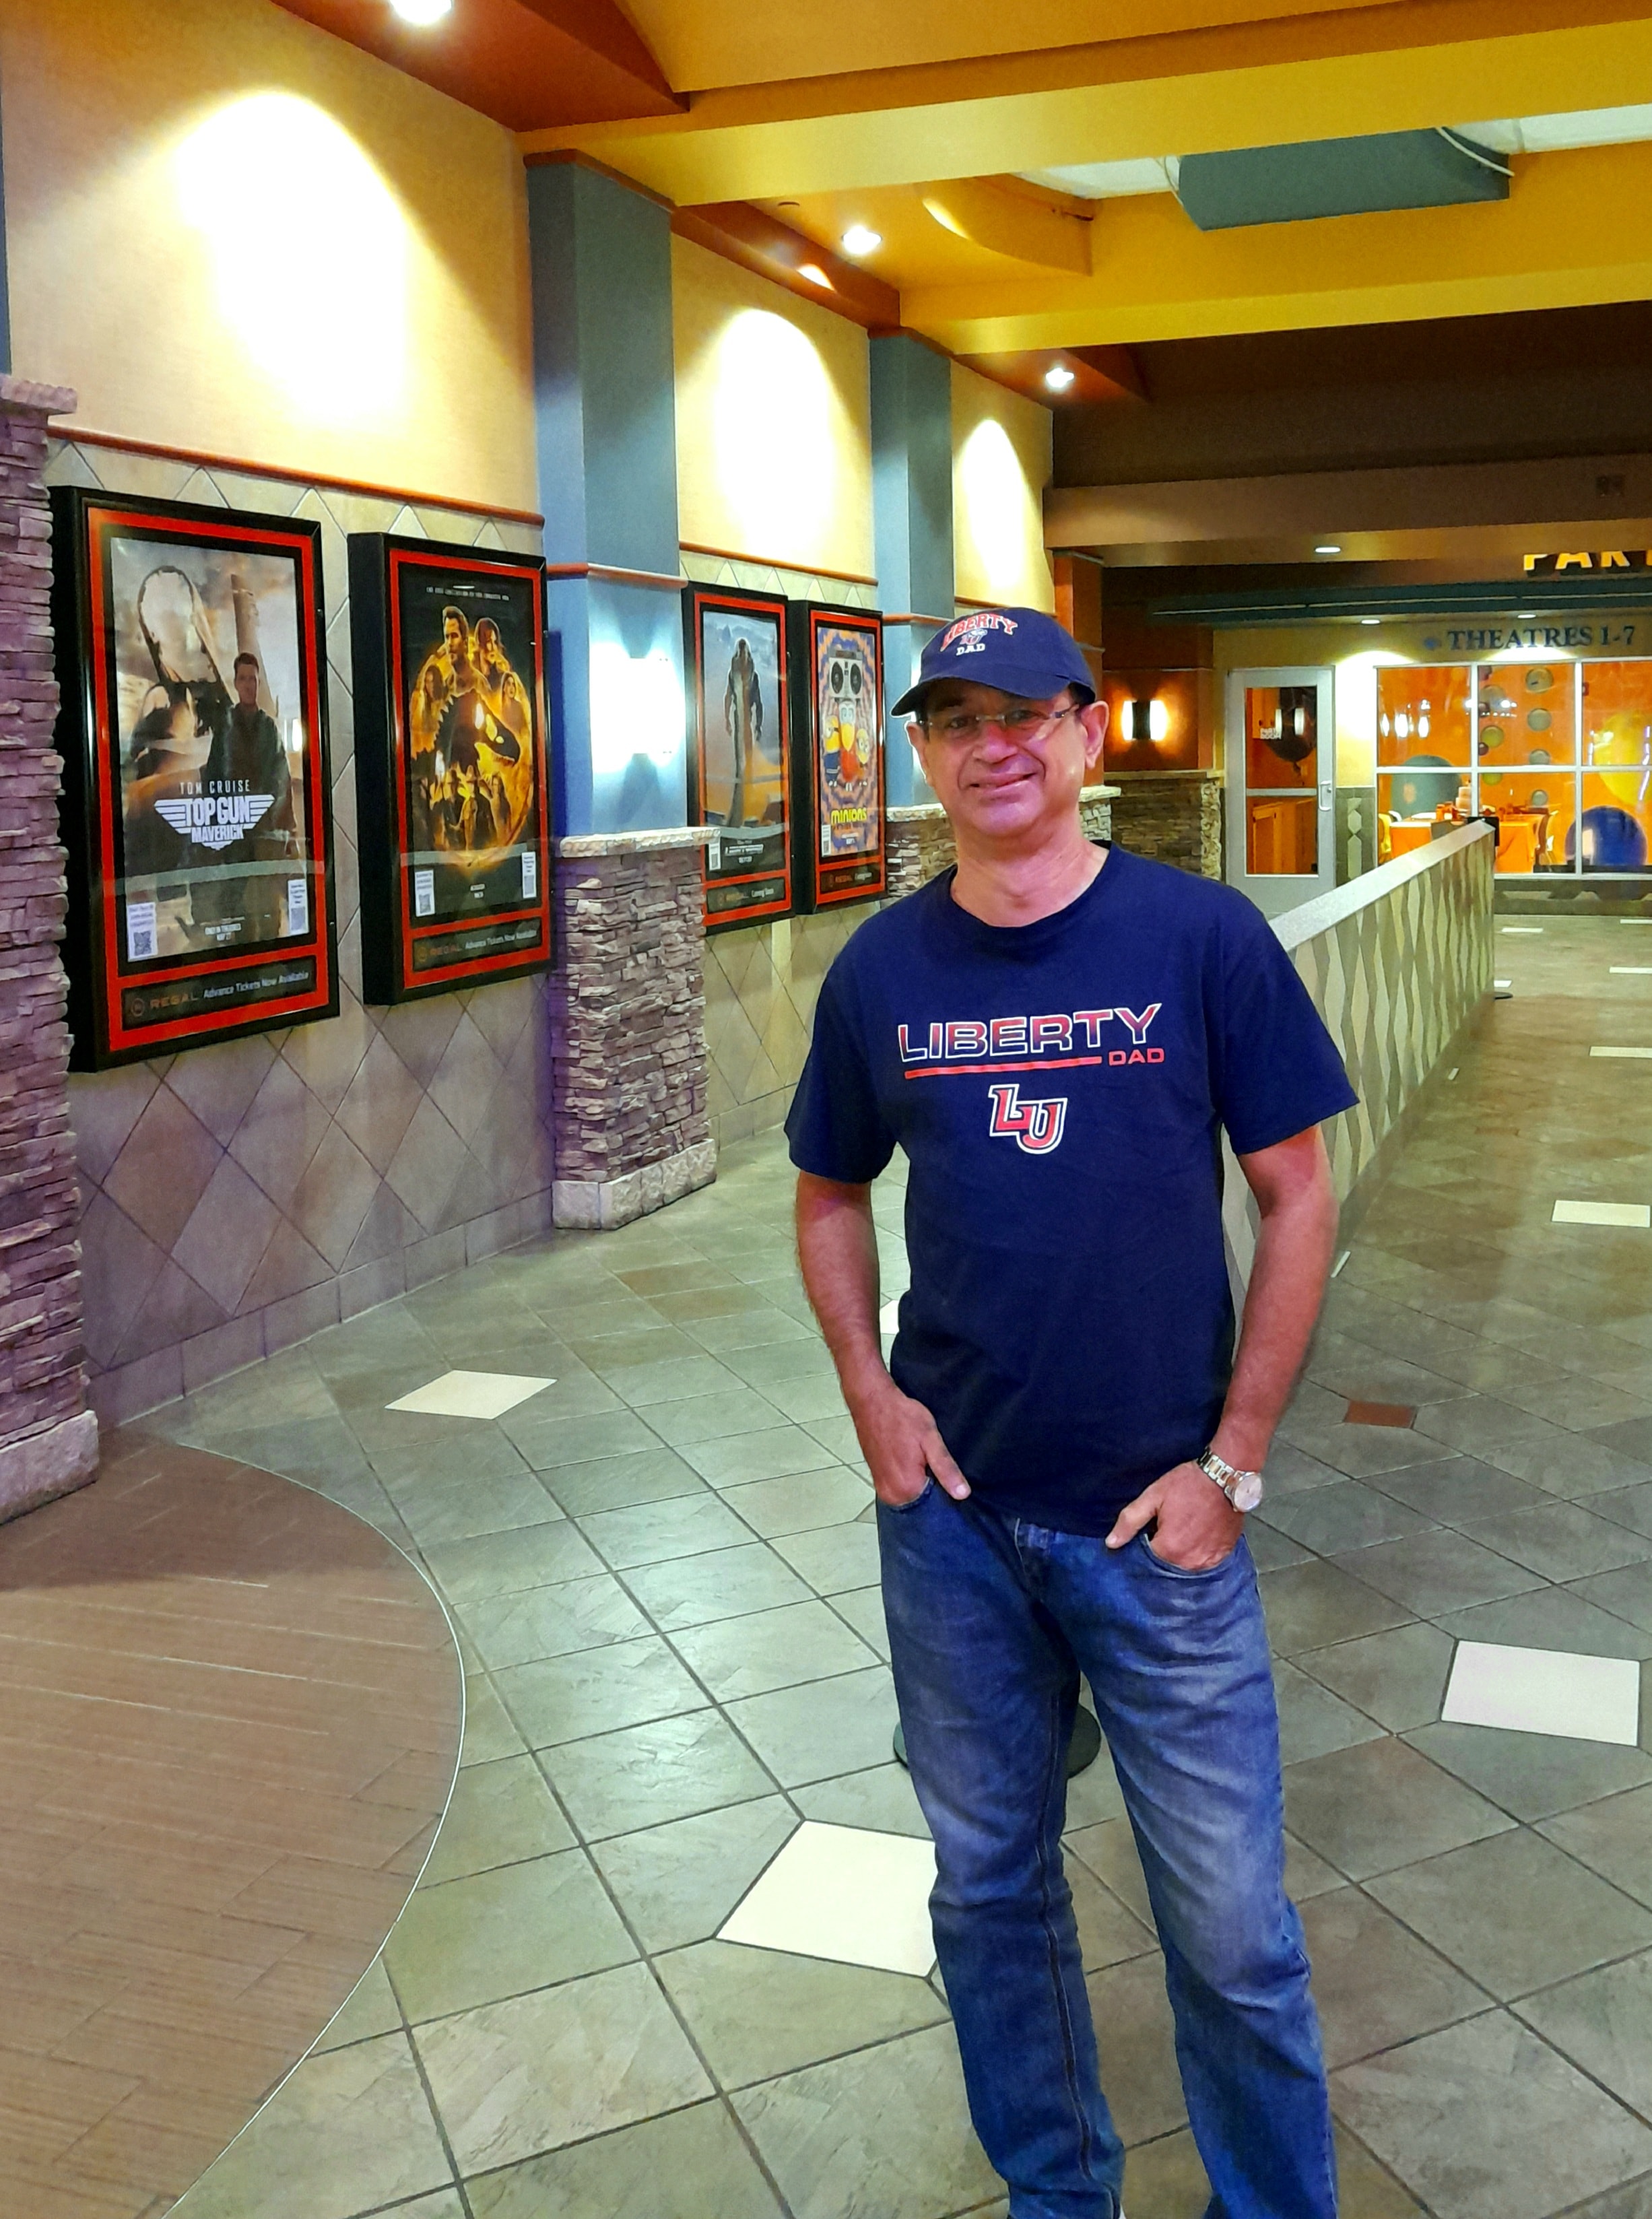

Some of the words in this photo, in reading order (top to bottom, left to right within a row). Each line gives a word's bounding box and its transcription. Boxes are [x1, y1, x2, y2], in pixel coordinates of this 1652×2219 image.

[940, 613, 1018, 652] LIBERTY
[1448, 626, 1593, 651] THEATRES
[1600, 625, 1635, 647] 1-7
[956, 643, 985, 656] DAD
[179, 781, 202, 795] TOM
[209, 779, 251, 794] CRUISE
[185, 797, 216, 827] TOP
[216, 795, 251, 825] GUN
[191, 824, 244, 843] MAVERICK
[150, 993, 200, 1009] REGAL
[203, 985, 234, 999] Advance
[235, 981, 260, 992] Tickets
[261, 978, 277, 987] Now
[278, 972, 309, 985] Available
[898, 1003, 1162, 1063] LIBERTY
[1109, 1047, 1164, 1066] DAD
[988, 1084, 1068, 1154] LU
